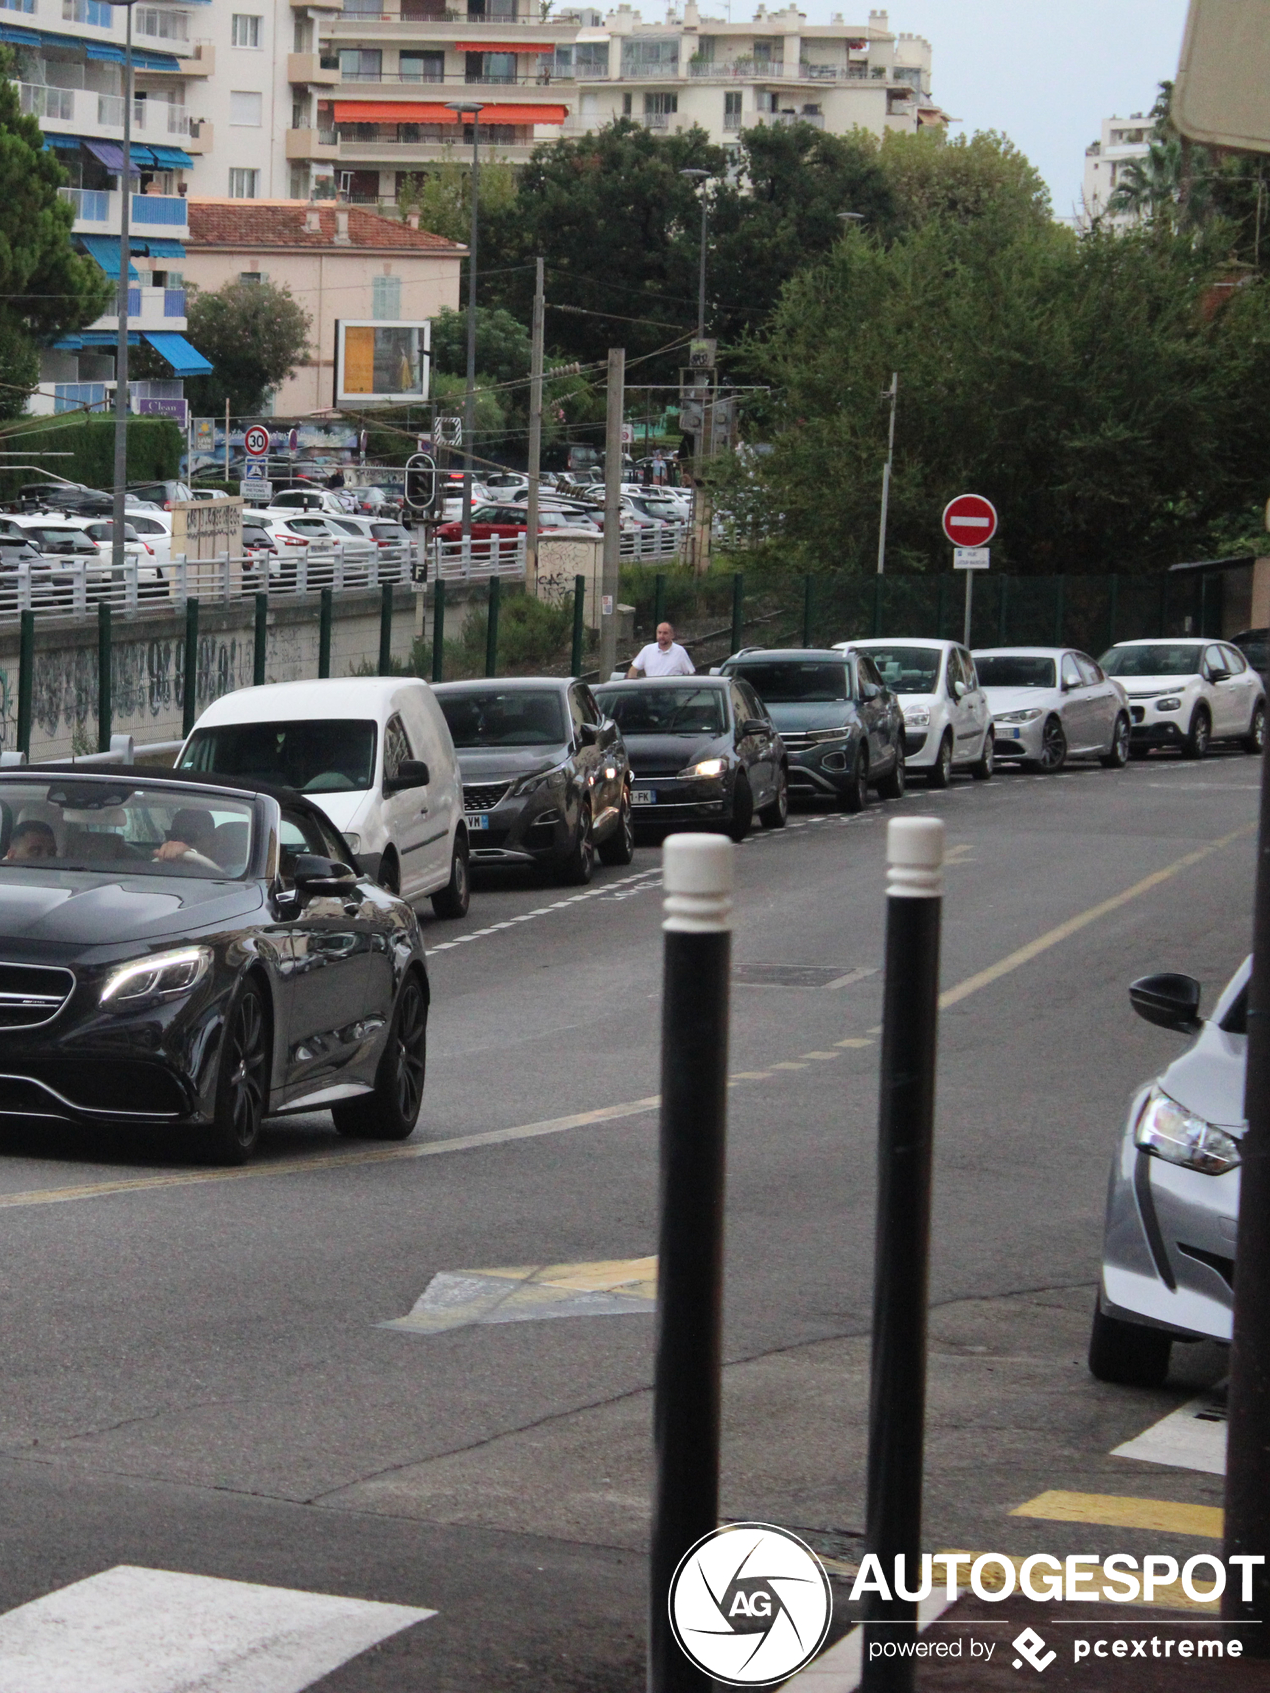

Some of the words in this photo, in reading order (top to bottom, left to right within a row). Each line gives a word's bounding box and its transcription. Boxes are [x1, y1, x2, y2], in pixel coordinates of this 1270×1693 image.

[148, 401, 177, 411] Clean
[249, 435, 264, 448] 30
[415, 566, 425, 580] F
